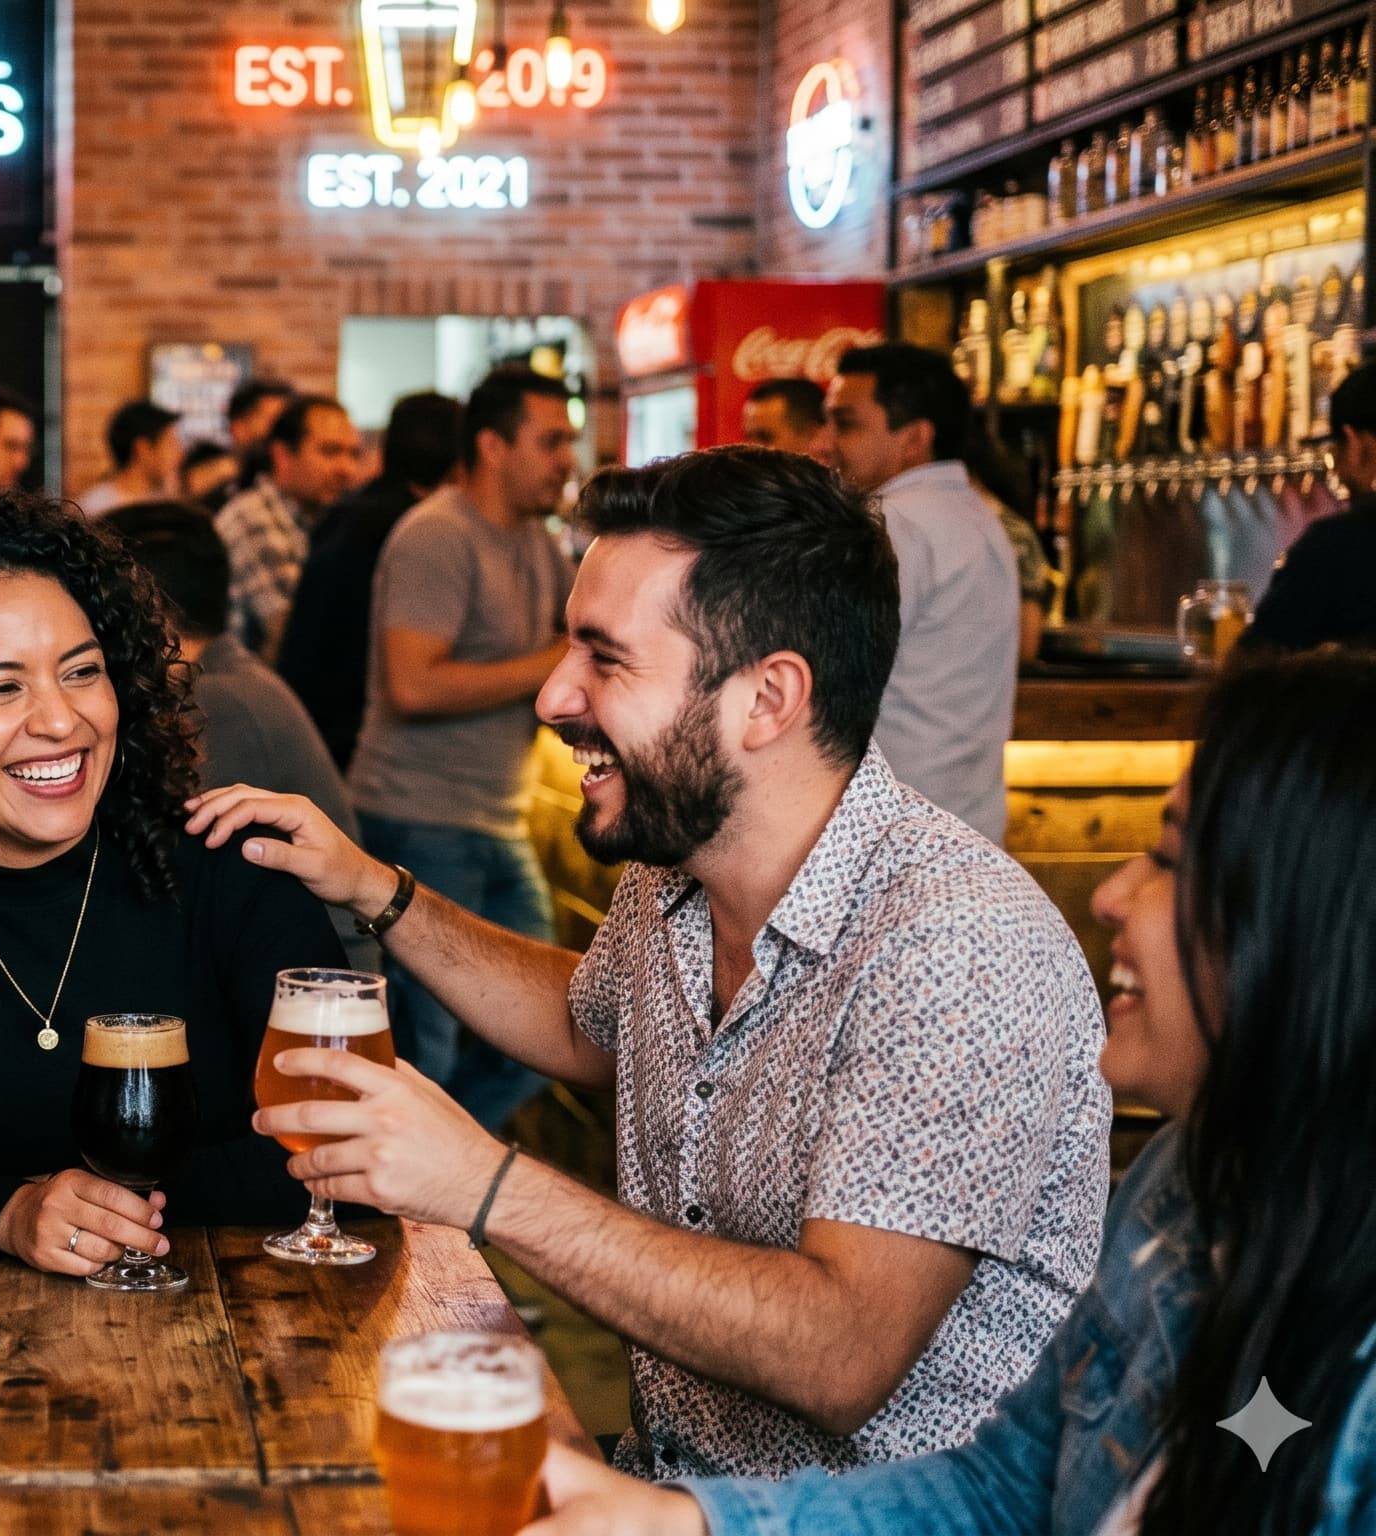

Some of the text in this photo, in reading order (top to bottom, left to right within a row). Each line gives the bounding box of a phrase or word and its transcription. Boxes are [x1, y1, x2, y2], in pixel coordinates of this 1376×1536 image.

[234, 45, 354, 107] EST.
[306, 153, 529, 210] EST. 2021
